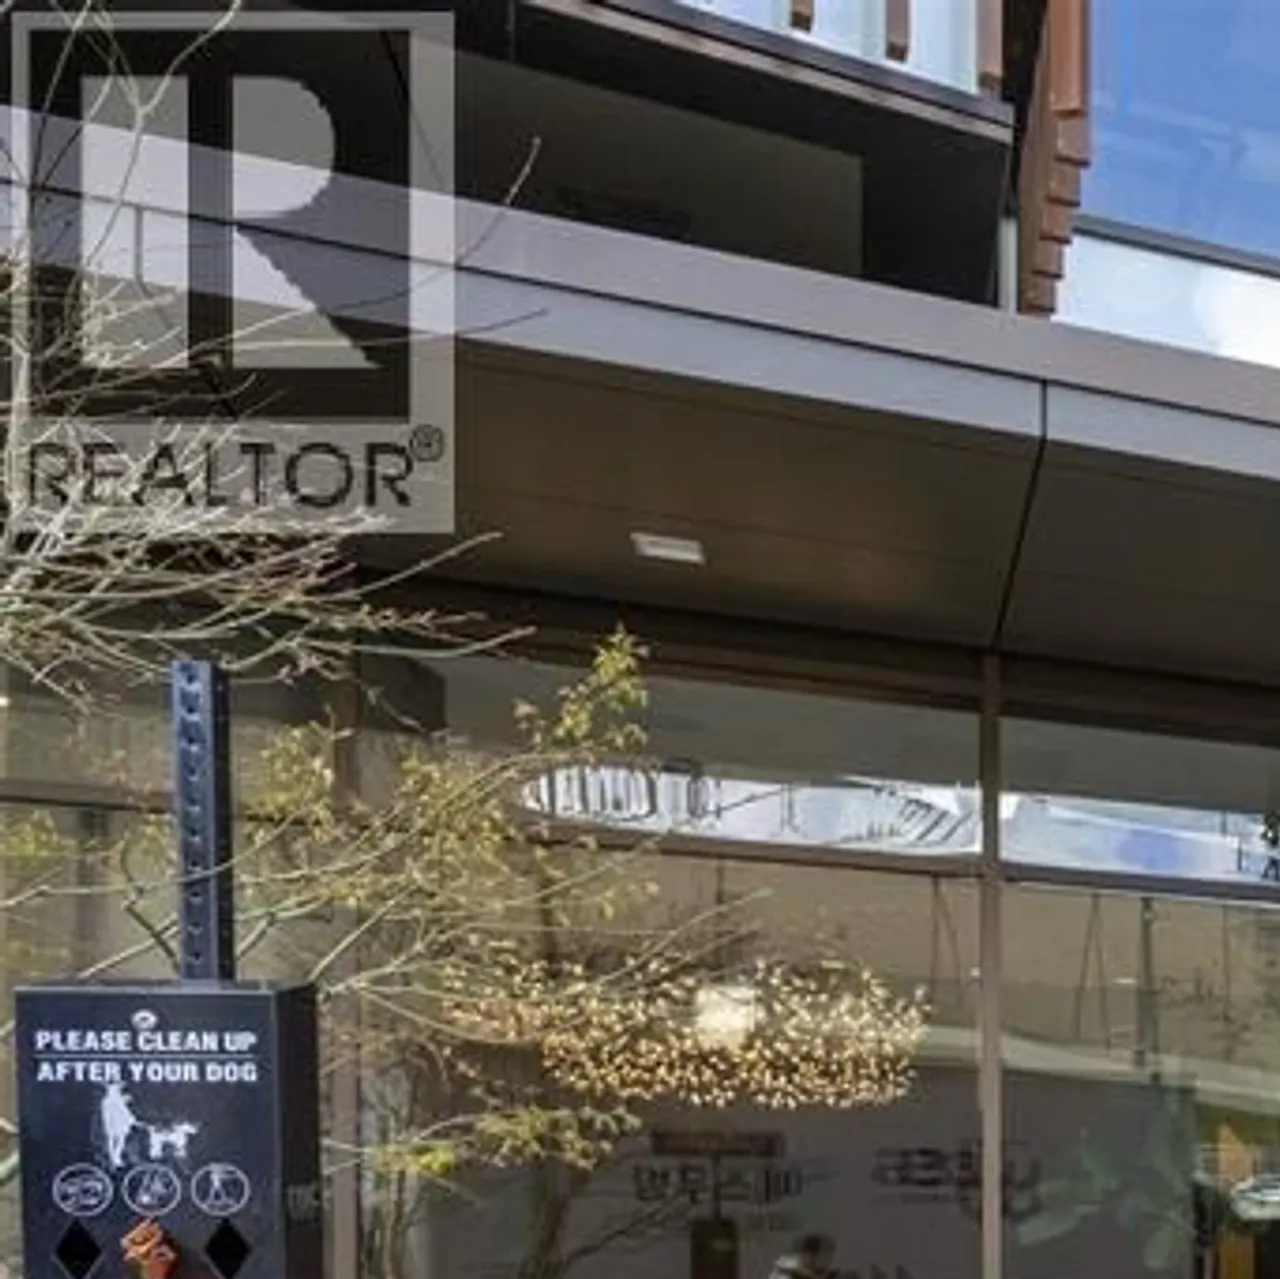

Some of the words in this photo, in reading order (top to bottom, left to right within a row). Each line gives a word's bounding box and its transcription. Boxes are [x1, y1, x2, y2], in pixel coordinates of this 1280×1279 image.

[35, 1029, 132, 1051] PLEASE
[137, 1029, 219, 1051] CLEAN
[223, 1029, 258, 1051] UP
[36, 1061, 122, 1082] AFTER
[129, 1061, 200, 1082] YOUR
[205, 1061, 258, 1082] DOG
